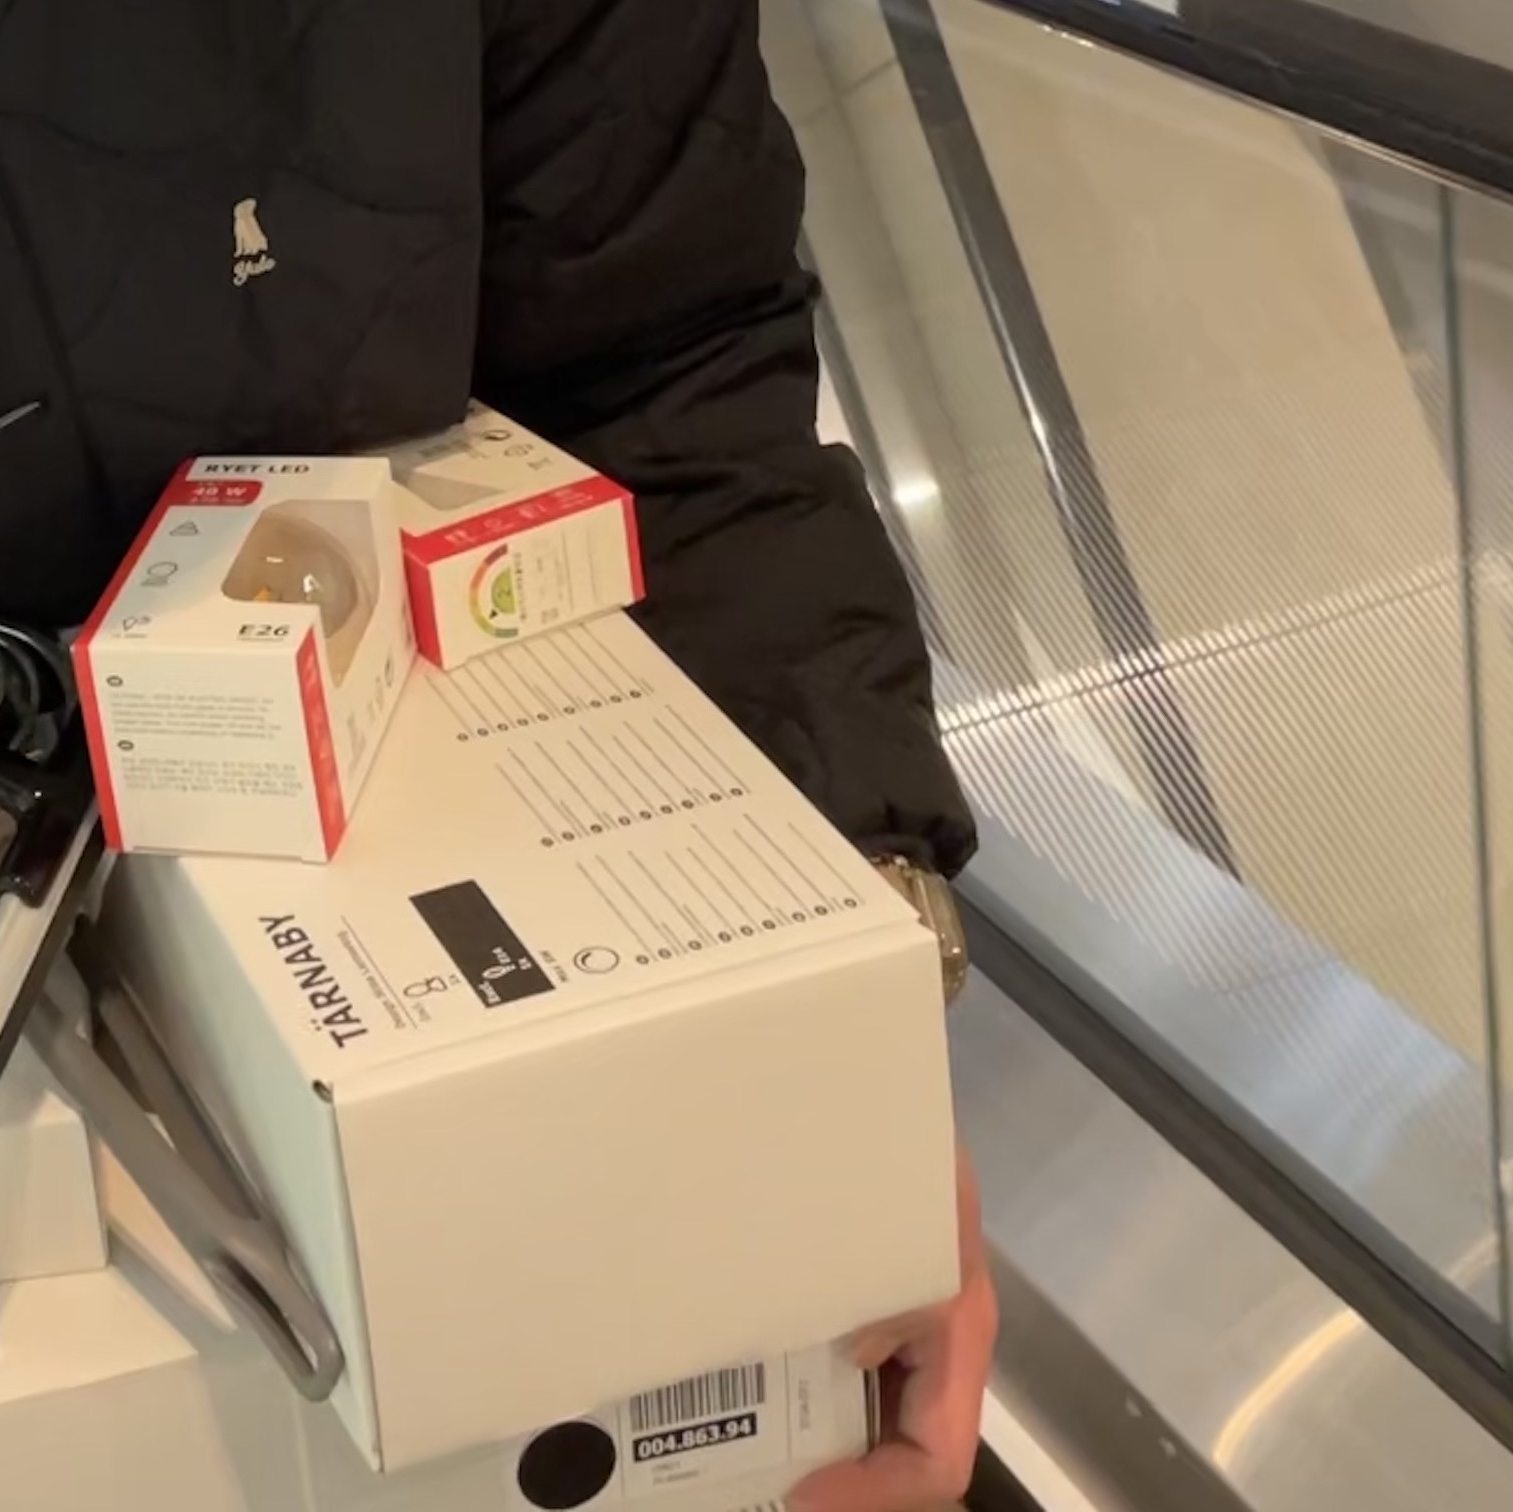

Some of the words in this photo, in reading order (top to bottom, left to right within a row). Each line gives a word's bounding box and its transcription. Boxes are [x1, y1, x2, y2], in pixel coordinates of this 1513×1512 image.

[203, 463, 262, 474] RYET
[267, 463, 311, 475] LED
[238, 624, 290, 637] E26
[258, 913, 369, 1049] TÄRNABY
[638, 1418, 752, 1460] 004.863.94
